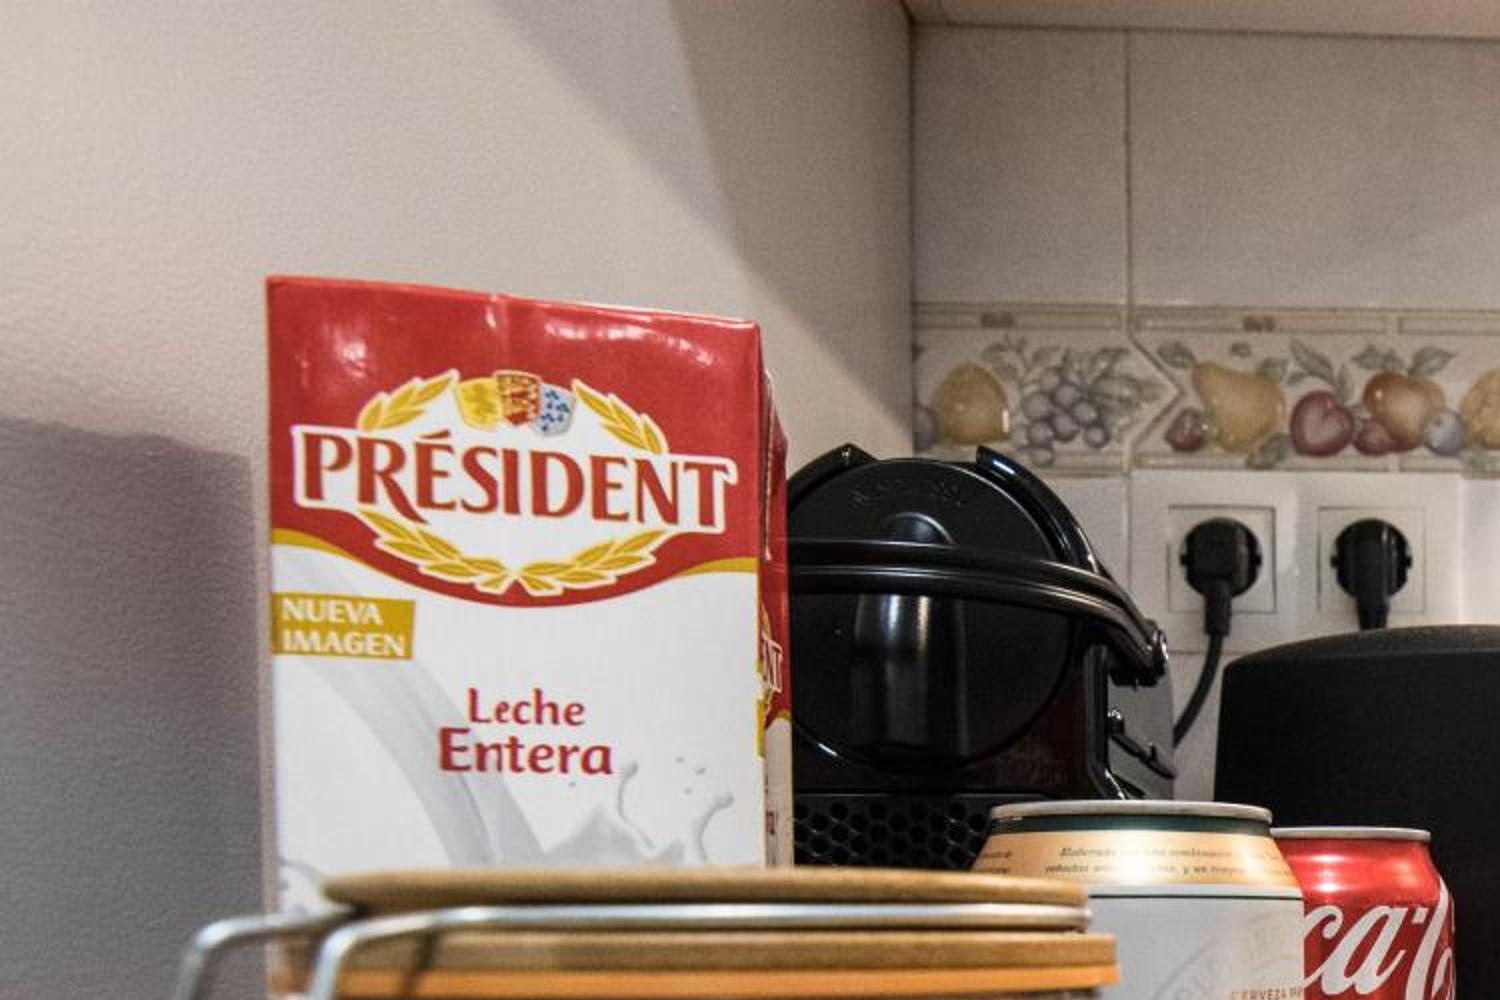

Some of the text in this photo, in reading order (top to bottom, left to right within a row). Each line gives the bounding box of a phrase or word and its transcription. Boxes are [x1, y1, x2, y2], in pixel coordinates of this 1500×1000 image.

[302, 430, 731, 527] PRÉSIDENT
[282, 598, 382, 626] NUEVA
[282, 629, 405, 656] IMAGEN
[468, 687, 585, 727] Leche
[438, 727, 614, 775] Entera
